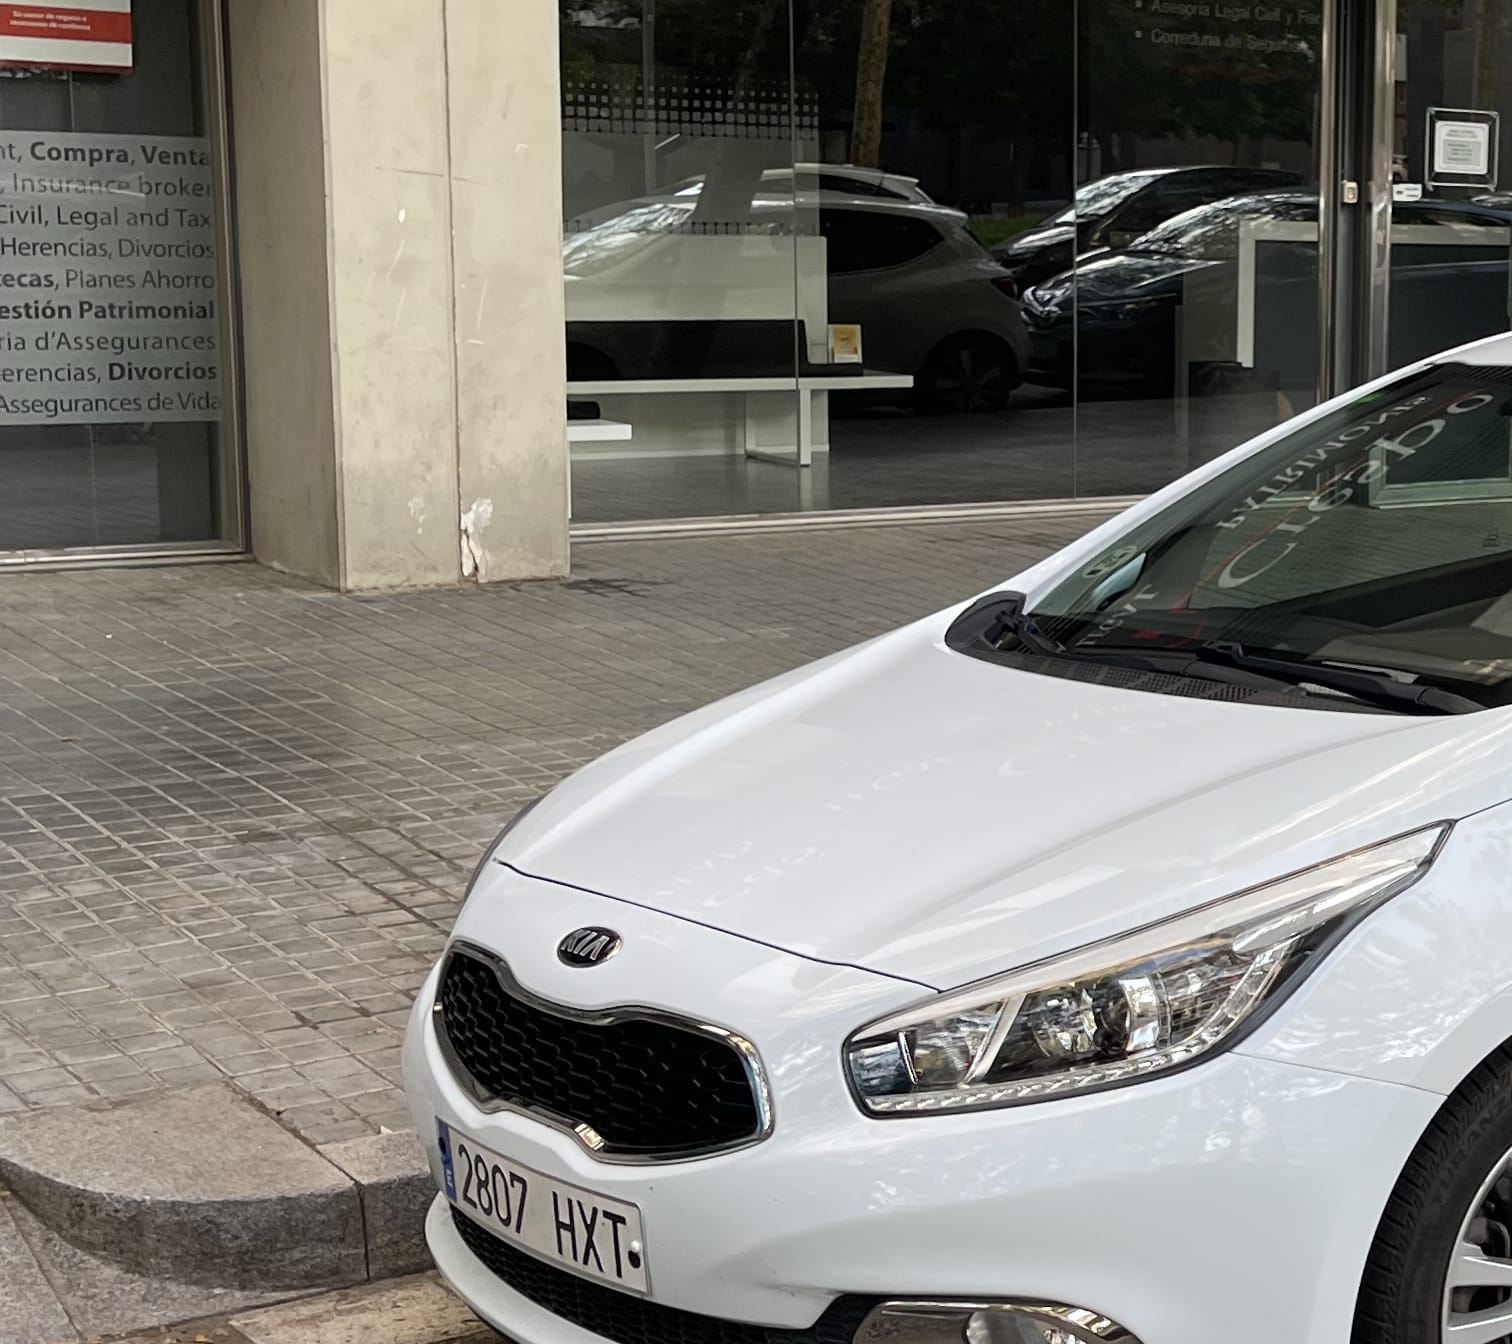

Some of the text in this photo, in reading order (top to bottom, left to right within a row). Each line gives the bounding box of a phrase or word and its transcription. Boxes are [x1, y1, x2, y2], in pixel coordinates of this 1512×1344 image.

[29, 141, 135, 168] Compra,
[140, 143, 210, 167] Venta
[13, 172, 130, 195] Insurance
[57, 204, 118, 231] Legal
[126, 207, 168, 227] and
[174, 208, 211, 228] Tax
[1, 237, 215, 260] Herencias, Divorcios
[0, 269, 216, 292] ecas, Planes Ahorro
[79, 300, 215, 320] Patrimonial
[108, 361, 217, 382] Divorcios
[147, 392, 174, 412] de
[177, 391, 221, 412] Vida
[560, 929, 610, 961] KIA
[457, 1143, 627, 1279] 2807 HXT
